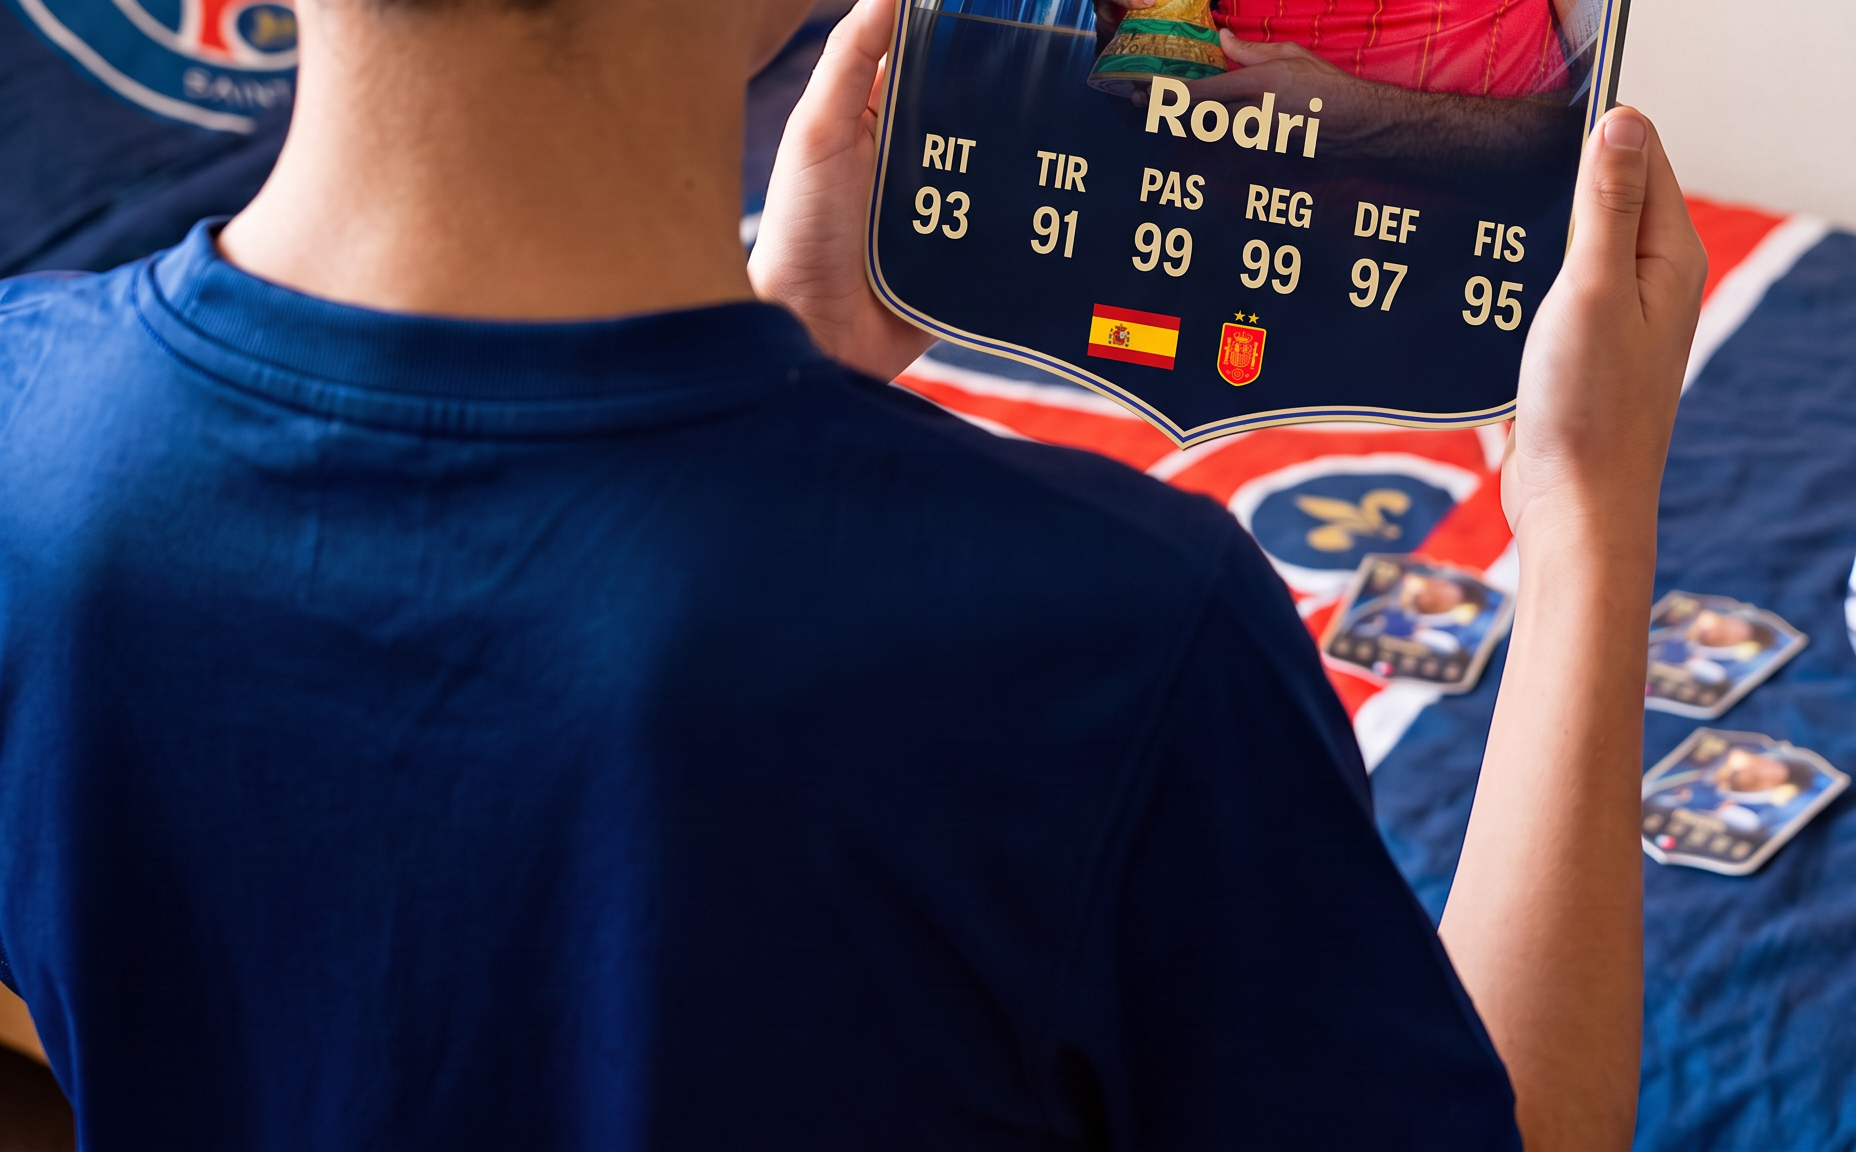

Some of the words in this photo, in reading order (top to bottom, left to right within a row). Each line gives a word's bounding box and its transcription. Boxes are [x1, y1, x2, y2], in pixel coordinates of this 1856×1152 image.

[1145, 76, 1323, 158] Rodri
[912, 186, 971, 239] 93
[1030, 206, 1079, 258] 91
[1131, 223, 1193, 277] 99
[1239, 239, 1302, 295] 99
[1348, 258, 1408, 312] 97
[1462, 275, 1524, 331] 95
[922, 134, 976, 174] RIT
[1036, 151, 1088, 193] TIR
[1139, 167, 1206, 211] PAS
[1245, 184, 1314, 229] REG
[1354, 201, 1420, 244] DEF
[1474, 220, 1527, 263] FIS
